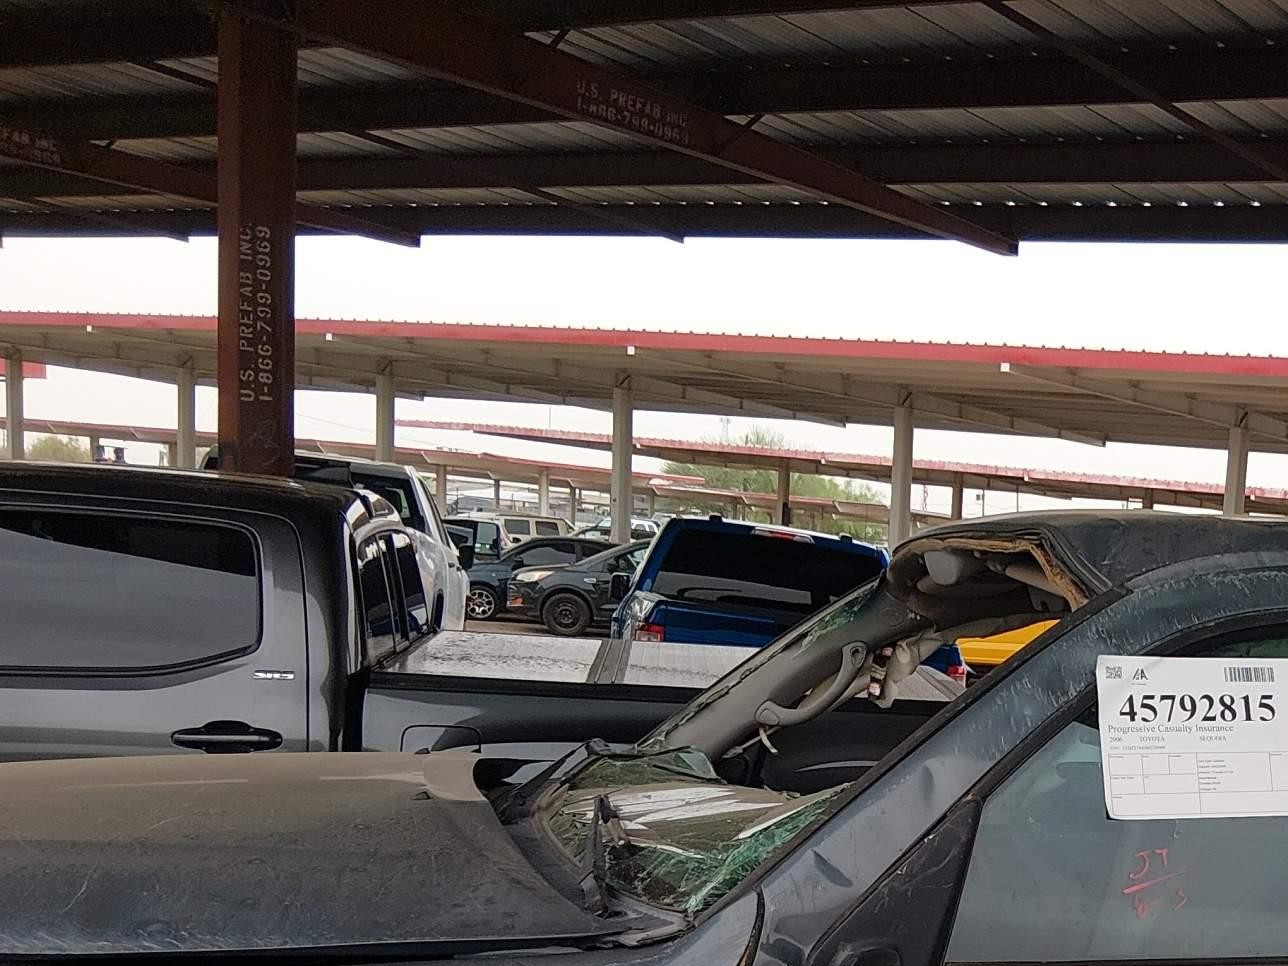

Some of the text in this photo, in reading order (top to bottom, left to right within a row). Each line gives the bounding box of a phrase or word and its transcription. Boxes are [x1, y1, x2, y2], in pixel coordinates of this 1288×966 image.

[239, 271, 255, 352] PREFAB
[256, 225, 274, 401] 1-866-799-0969
[239, 363, 256, 402] U.S.
[1119, 693, 1276, 723] 45792815
[1108, 724, 1234, 735] Progressive Casualty Insurance
